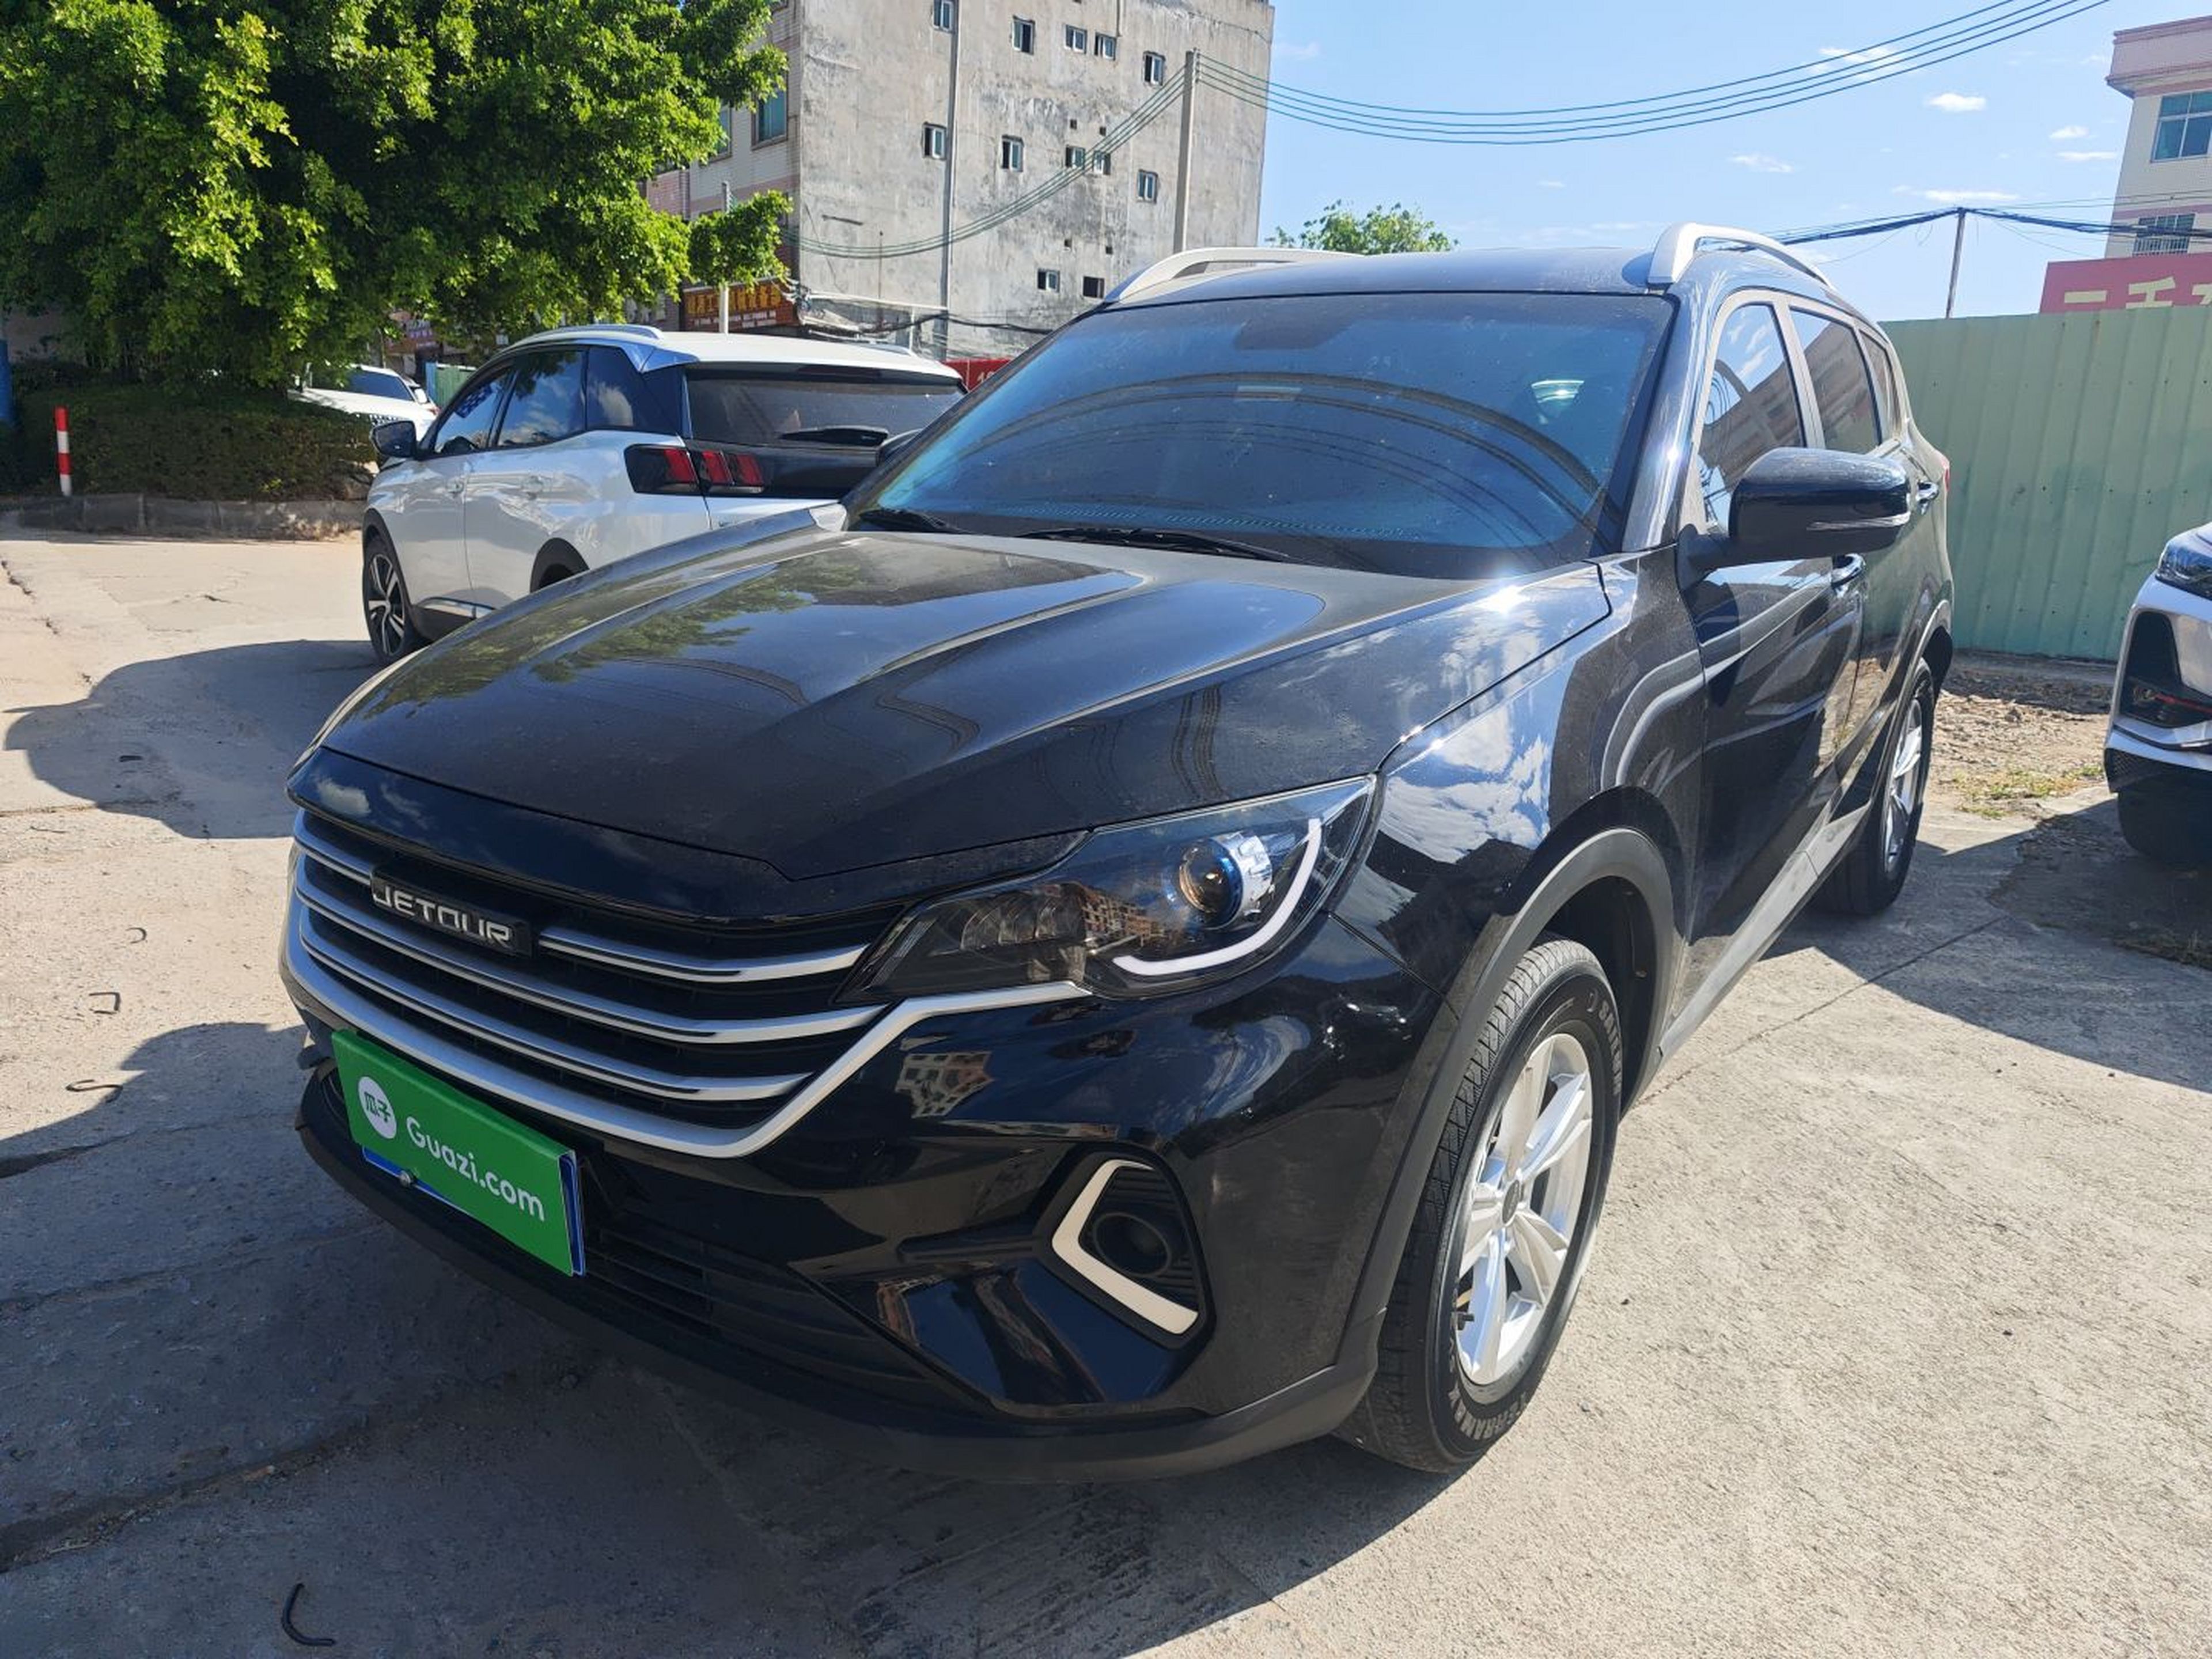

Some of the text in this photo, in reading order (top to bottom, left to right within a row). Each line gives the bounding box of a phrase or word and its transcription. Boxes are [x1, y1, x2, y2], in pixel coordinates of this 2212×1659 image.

[373, 885, 512, 950] JETOUR
[363, 1091, 391, 1123] 瓜子
[406, 1116, 545, 1222] Guazi.com
